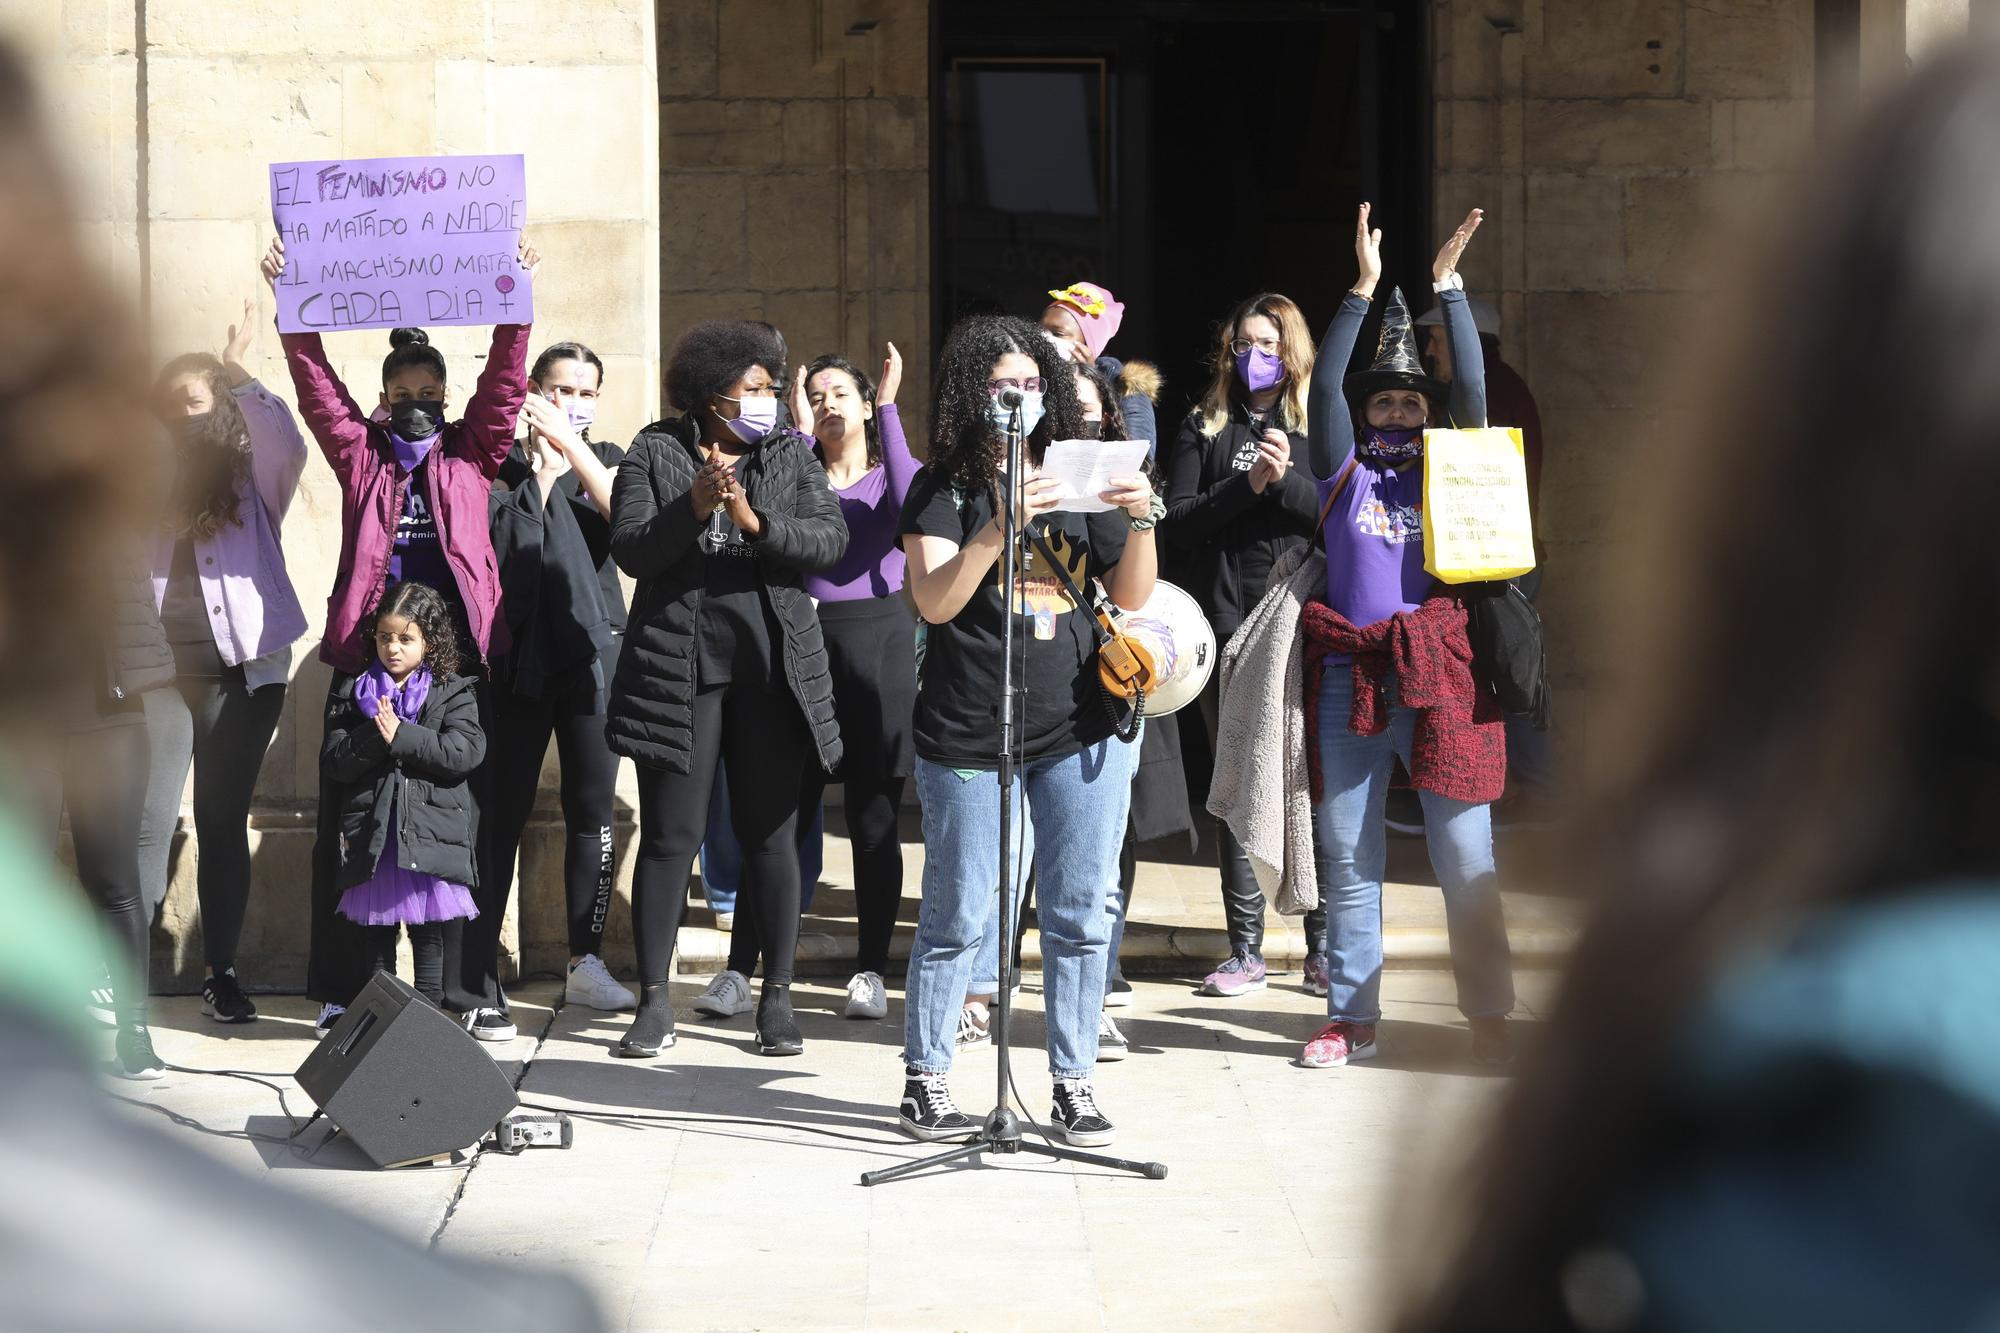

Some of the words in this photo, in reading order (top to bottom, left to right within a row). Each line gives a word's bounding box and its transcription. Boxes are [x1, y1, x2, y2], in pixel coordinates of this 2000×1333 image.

[274, 167, 311, 206] EL
[458, 165, 495, 190] NO
[279, 221, 310, 244] HA
[322, 209, 407, 243] MATADO
[421, 211, 434, 231] A
[443, 194, 523, 235] NADIE
[280, 258, 309, 286] EL
[321, 253, 443, 283] MACHISMO
[454, 252, 512, 274] MATA
[298, 289, 402, 327] CADA
[600, 825, 613, 872] APART
[591, 878, 611, 933] OCEANS
